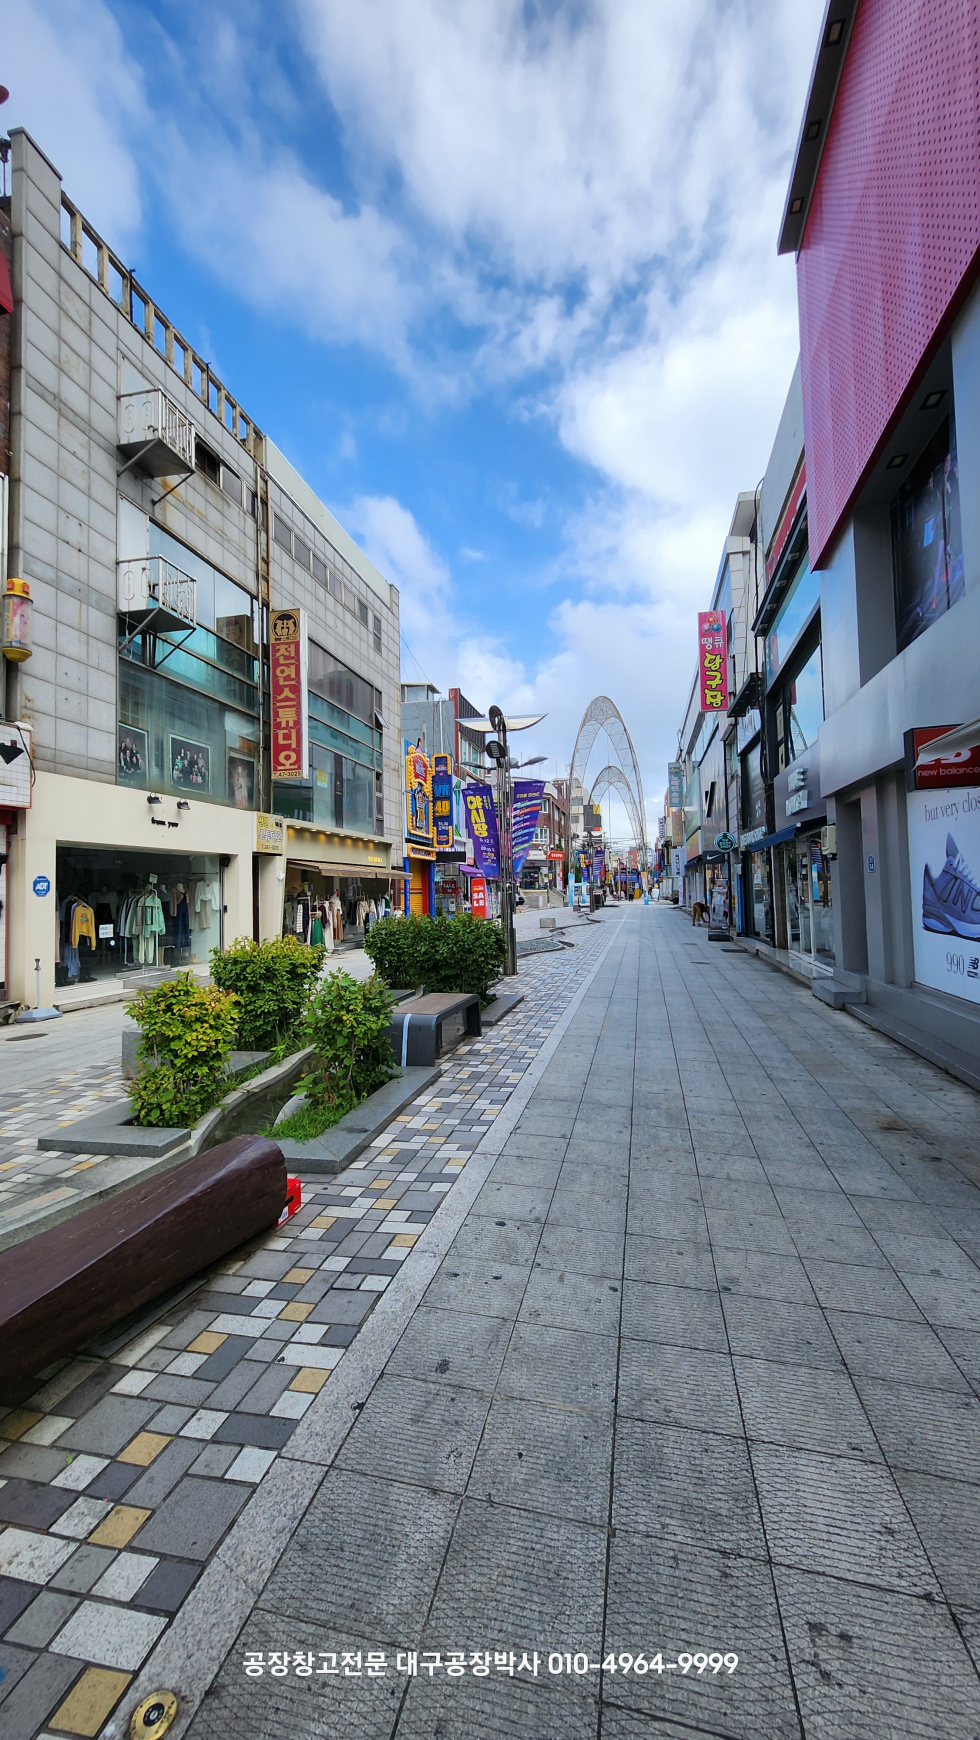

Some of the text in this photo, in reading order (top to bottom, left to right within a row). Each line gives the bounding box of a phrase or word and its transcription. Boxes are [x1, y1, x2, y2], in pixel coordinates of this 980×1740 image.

[701, 636, 725, 650] 땡큐
[703, 651, 726, 708] 당구장
[275, 643, 298, 770] 천연스튜디오
[917, 766, 980, 777] new balance
[434, 784, 449, 797] VR
[435, 800, 450, 813] 4D
[924, 804, 939, 822] but
[940, 801, 960, 821] very
[466, 795, 488, 837] 야시장
[258, 829, 282, 843] 스튜디오
[35, 882, 48, 890] ADT
[473, 899, 484, 907] LE
[946, 952, 965, 976] 990
